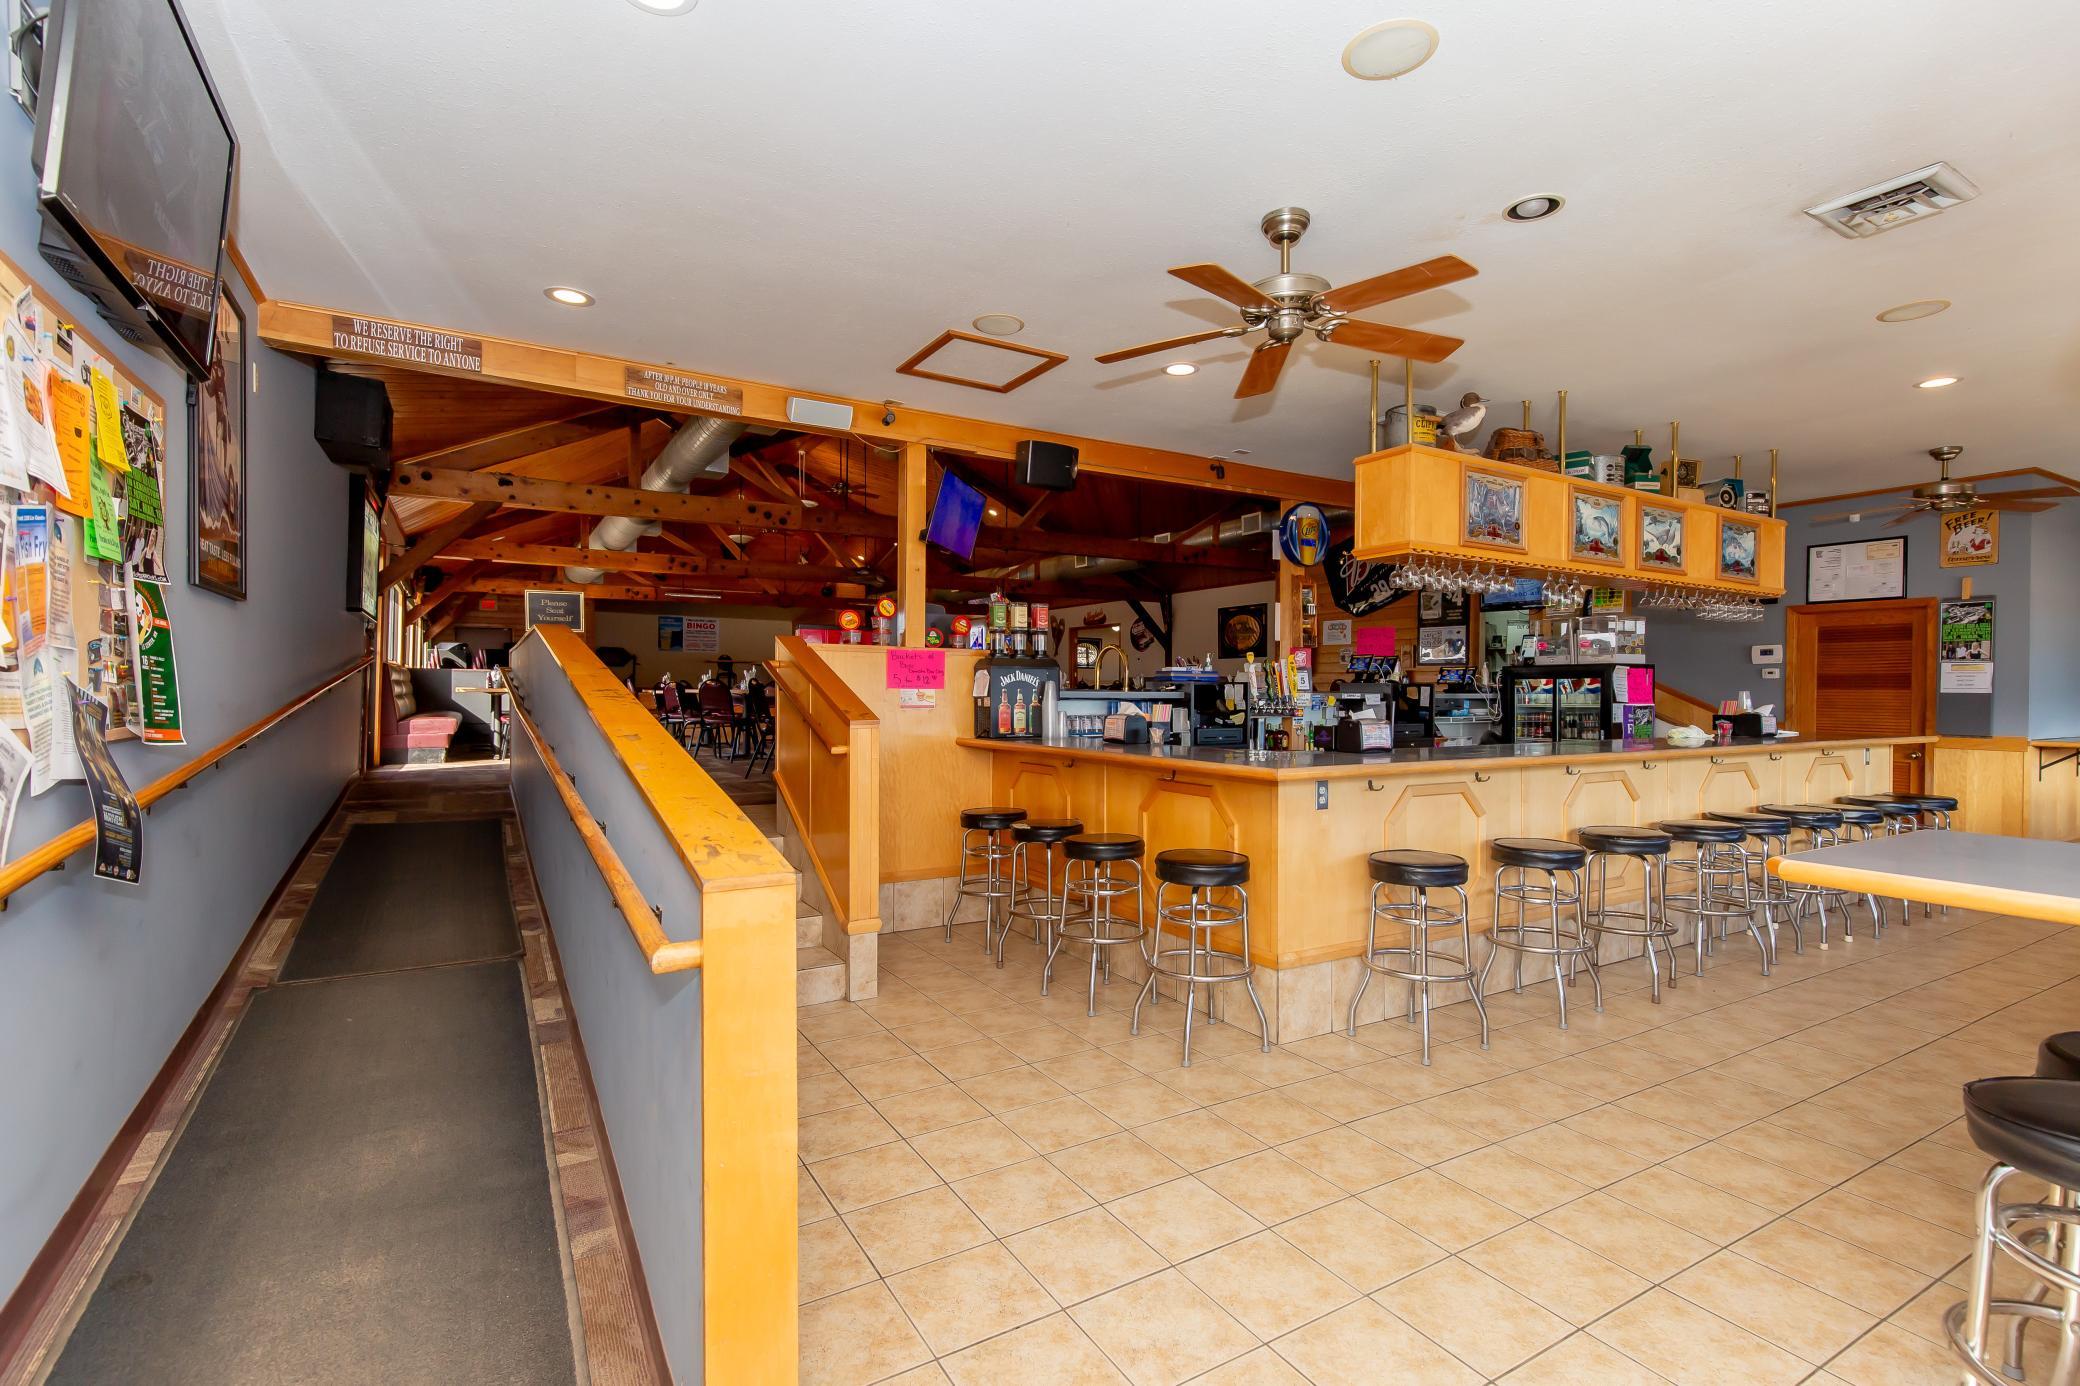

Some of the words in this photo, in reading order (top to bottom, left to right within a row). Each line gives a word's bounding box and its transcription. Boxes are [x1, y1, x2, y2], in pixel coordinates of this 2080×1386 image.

[353, 318, 368, 335] WE
[370, 322, 412, 343] RESERVE
[414, 329, 432, 347] THE
[434, 333, 464, 352] RIGHT
[334, 332, 348, 348] TO
[350, 336, 386, 355] REFUSE
[388, 342, 426, 363] SERVICE
[428, 350, 442, 364] TO
[443, 352, 480, 371] ANYONE
[644, 369, 662, 382] AFTER
[681, 378, 702, 390] PEOPLE
[710, 382, 728, 394] YEARS
[654, 382, 668, 392] OLD
[668, 384, 681, 394] AND
[681, 387, 698, 398] OVER
[698, 390, 714, 401] ONLY
[628, 386, 649, 399] THANK
[650, 390, 662, 400] YOU
[664, 393, 675, 403] FOR
[676, 395, 692, 406] YOUR
[692, 398, 741, 416] UNDERSTANDING
[1944, 511, 1977, 530] FREE
[34, 535, 48, 562] Fry
[540, 599, 568, 607] Please
[538, 614, 574, 622] Yourself
[686, 622, 716, 630] BINGO
[142, 656, 148, 665] 16
[890, 650, 922, 660] Buckets
[1000, 672, 1016, 687] JACK
[1300, 676, 1306, 684] 5
